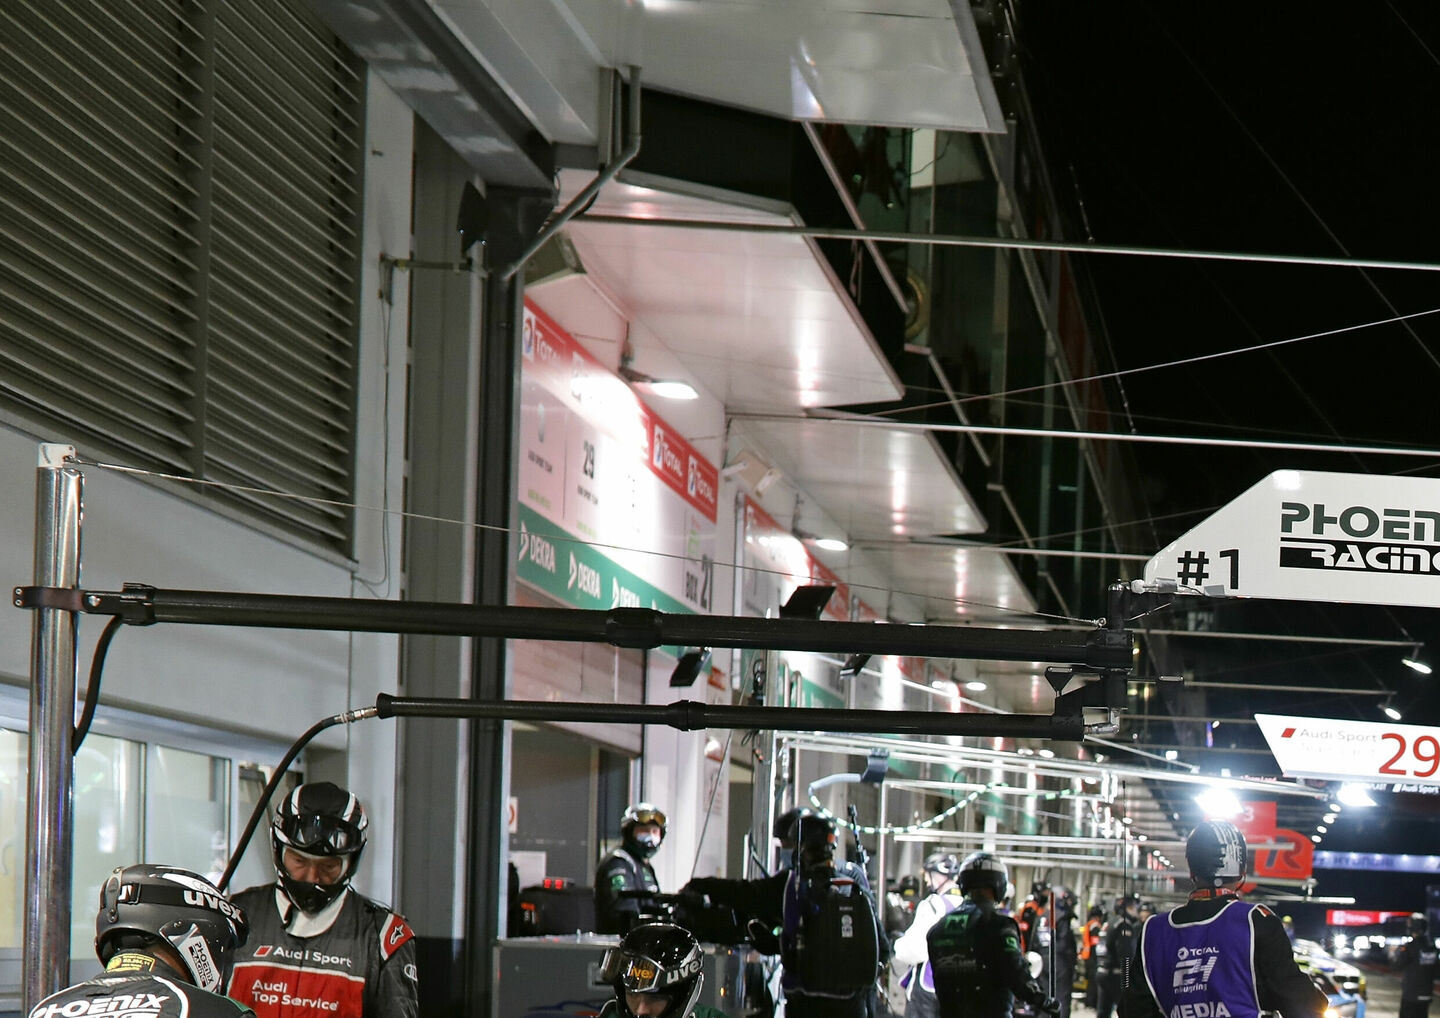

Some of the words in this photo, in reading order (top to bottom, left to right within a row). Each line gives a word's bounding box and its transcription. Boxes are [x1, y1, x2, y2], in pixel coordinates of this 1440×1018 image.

[663, 443, 683, 478] TOTAL
[530, 534, 556, 574] DEKRA
[1177, 548, 1240, 590] #1
[577, 562, 601, 599] DEKRA
[1300, 728, 1333, 740] Audi
[1337, 730, 1378, 743] Sport
[1402, 784, 1418, 793] Audi
[1418, 785, 1439, 795] Sport
[184, 889, 243, 924] uvex
[273, 946, 309, 961] Audi
[312, 949, 352, 967] Sport
[1190, 946, 1219, 956] TOTAL
[252, 979, 287, 993] Audi
[252, 990, 278, 1006] Top
[281, 993, 338, 1010] Service
